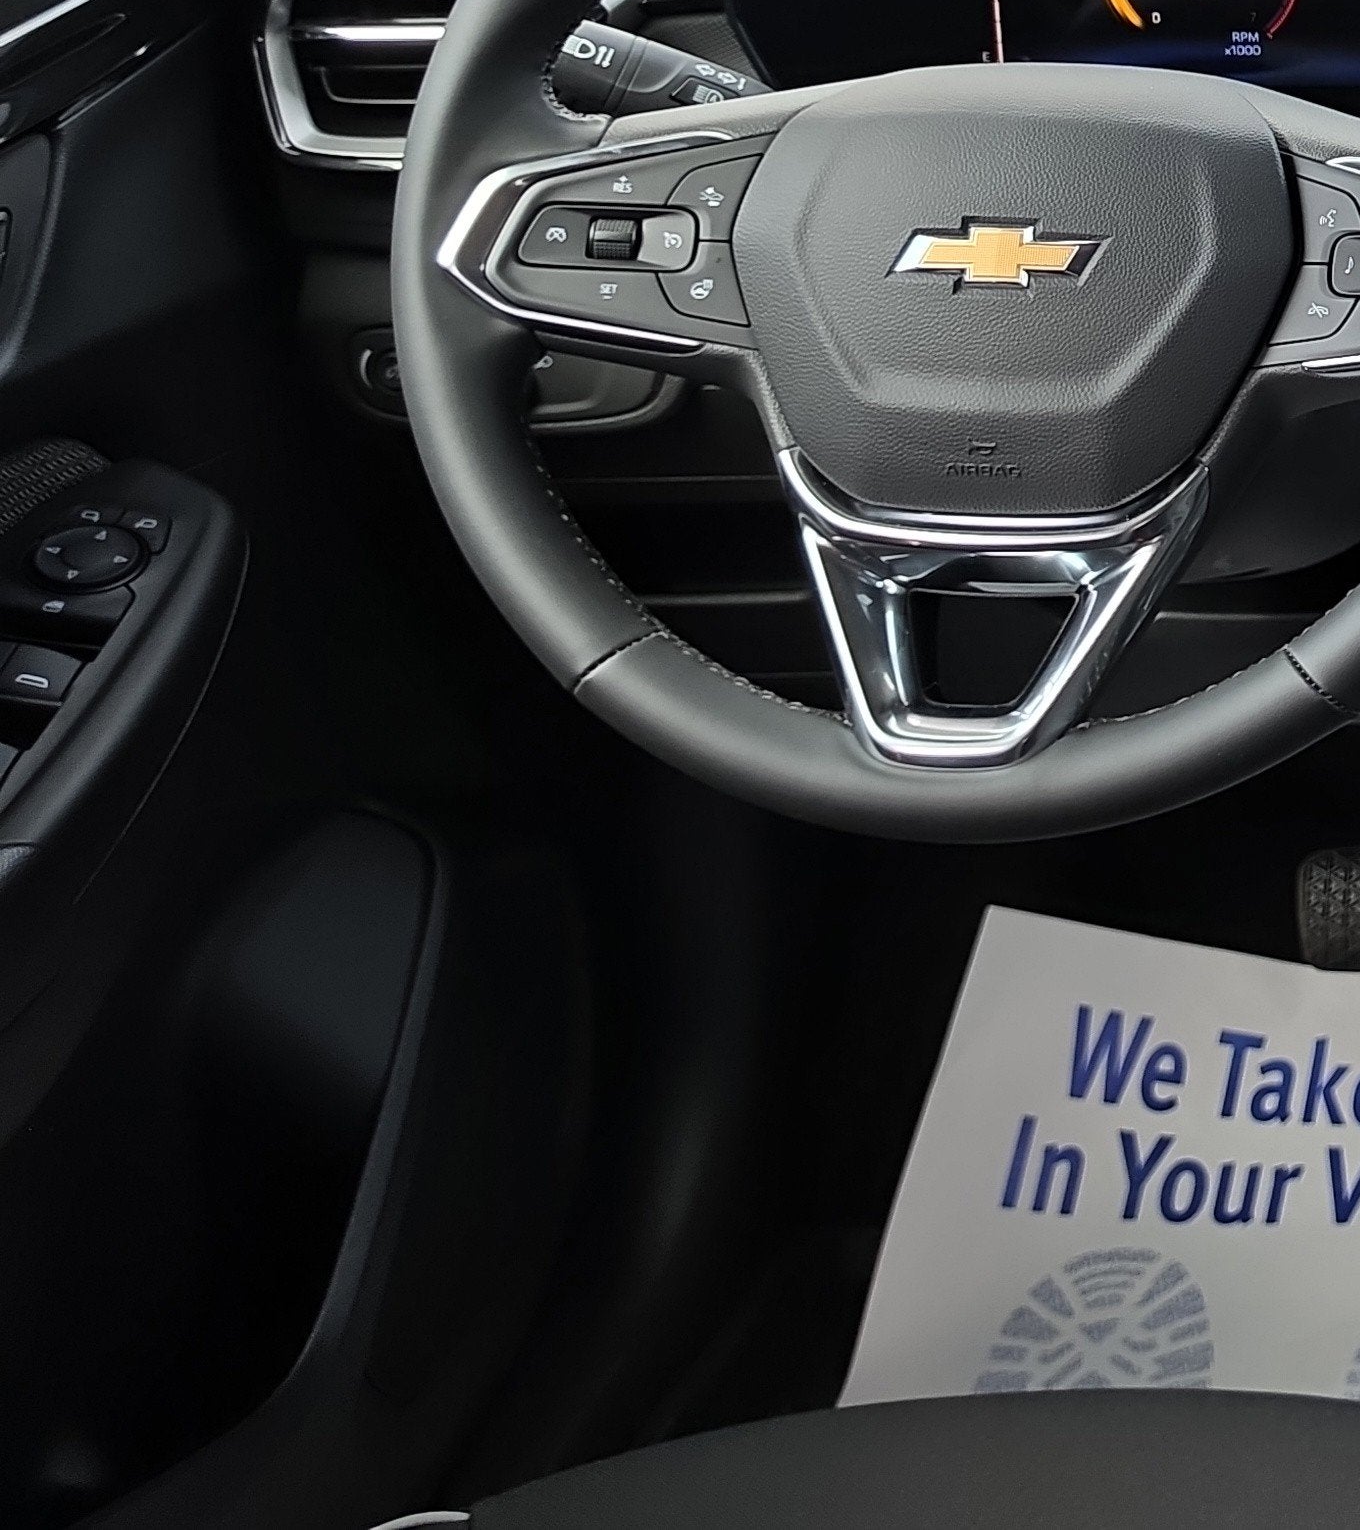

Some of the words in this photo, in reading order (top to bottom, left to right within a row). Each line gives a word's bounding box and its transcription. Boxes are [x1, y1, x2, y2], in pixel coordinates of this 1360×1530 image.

[1151, 12, 1162, 24] 0
[1231, 31, 1261, 44] RPM
[982, 51, 991, 63] E
[1224, 44, 1262, 57] x1000
[599, 283, 619, 295] SET
[945, 462, 1023, 478] AIRBAG
[1069, 1003, 1188, 1112] We
[1000, 1114, 1087, 1216] In
[1118, 1127, 1304, 1225] Your
